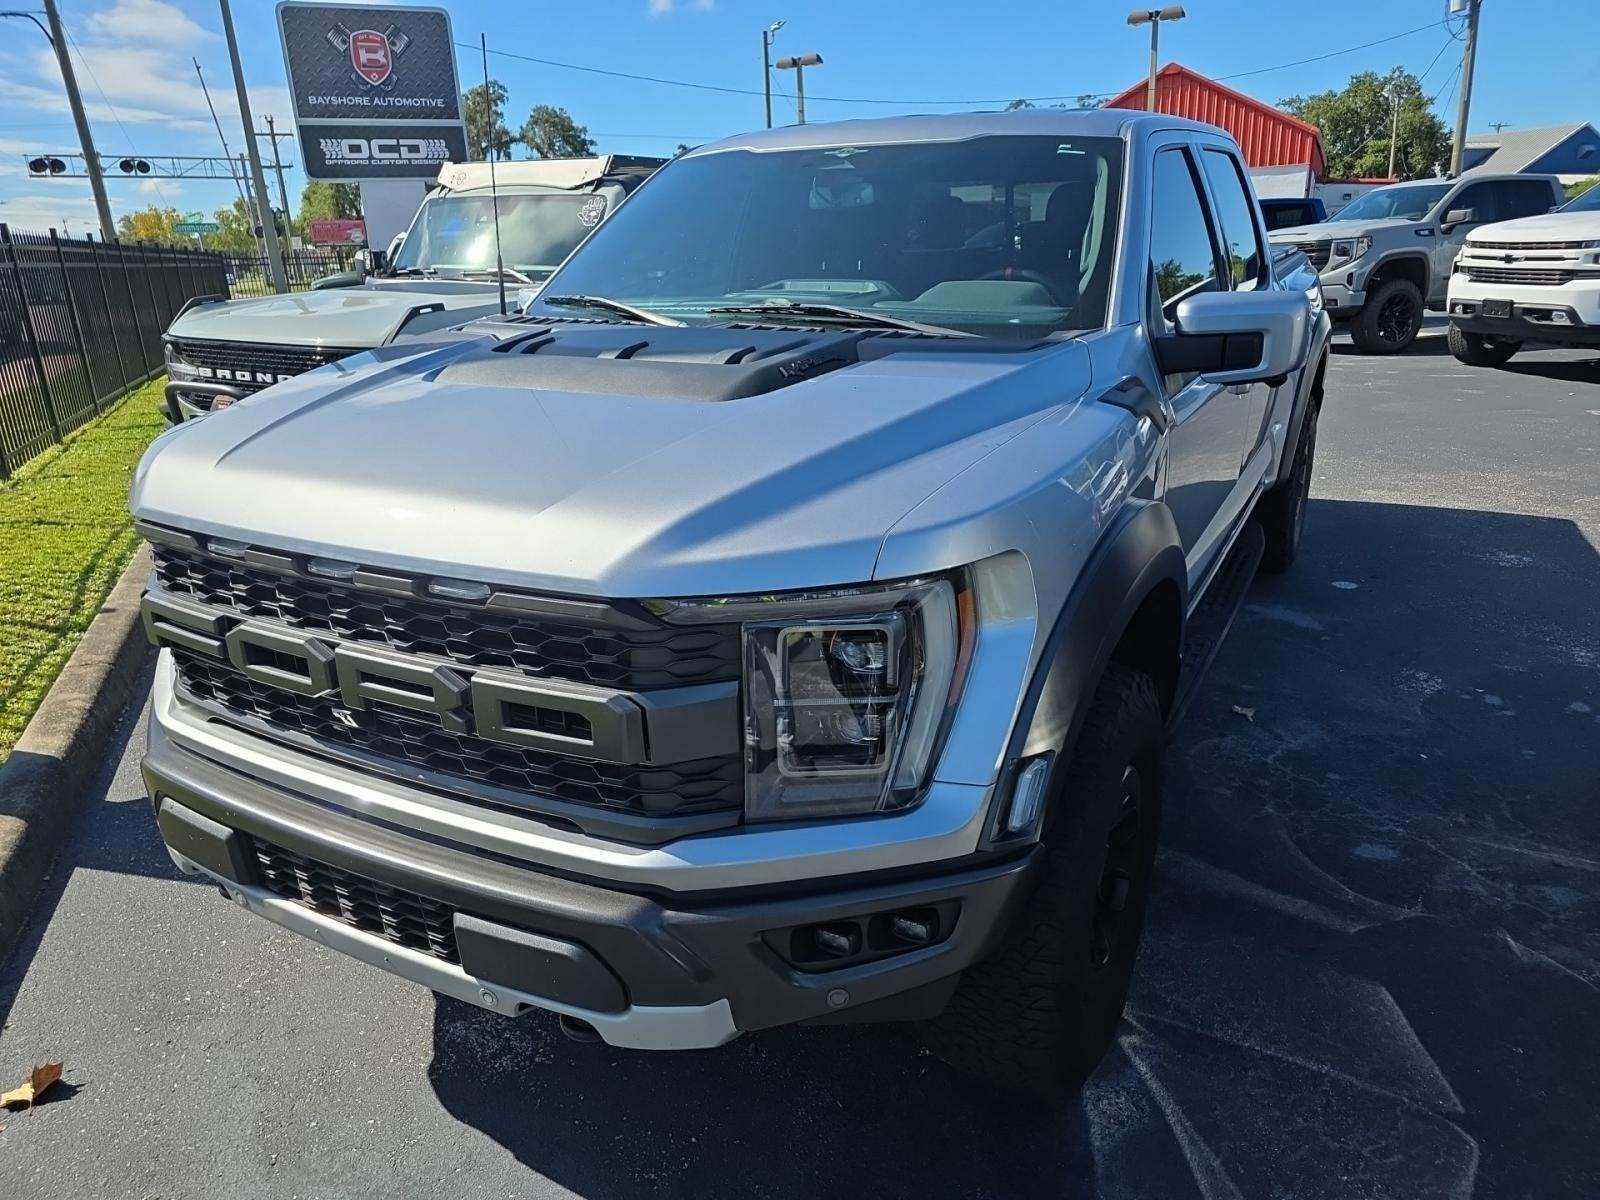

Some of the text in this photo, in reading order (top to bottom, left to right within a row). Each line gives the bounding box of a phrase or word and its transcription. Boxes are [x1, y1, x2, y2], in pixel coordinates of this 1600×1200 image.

[358, 43, 388, 70] B
[308, 96, 445, 107] BAYSHORE AUTOMOTIVE
[341, 139, 427, 158] OCD
[141, 591, 650, 766] FORD
